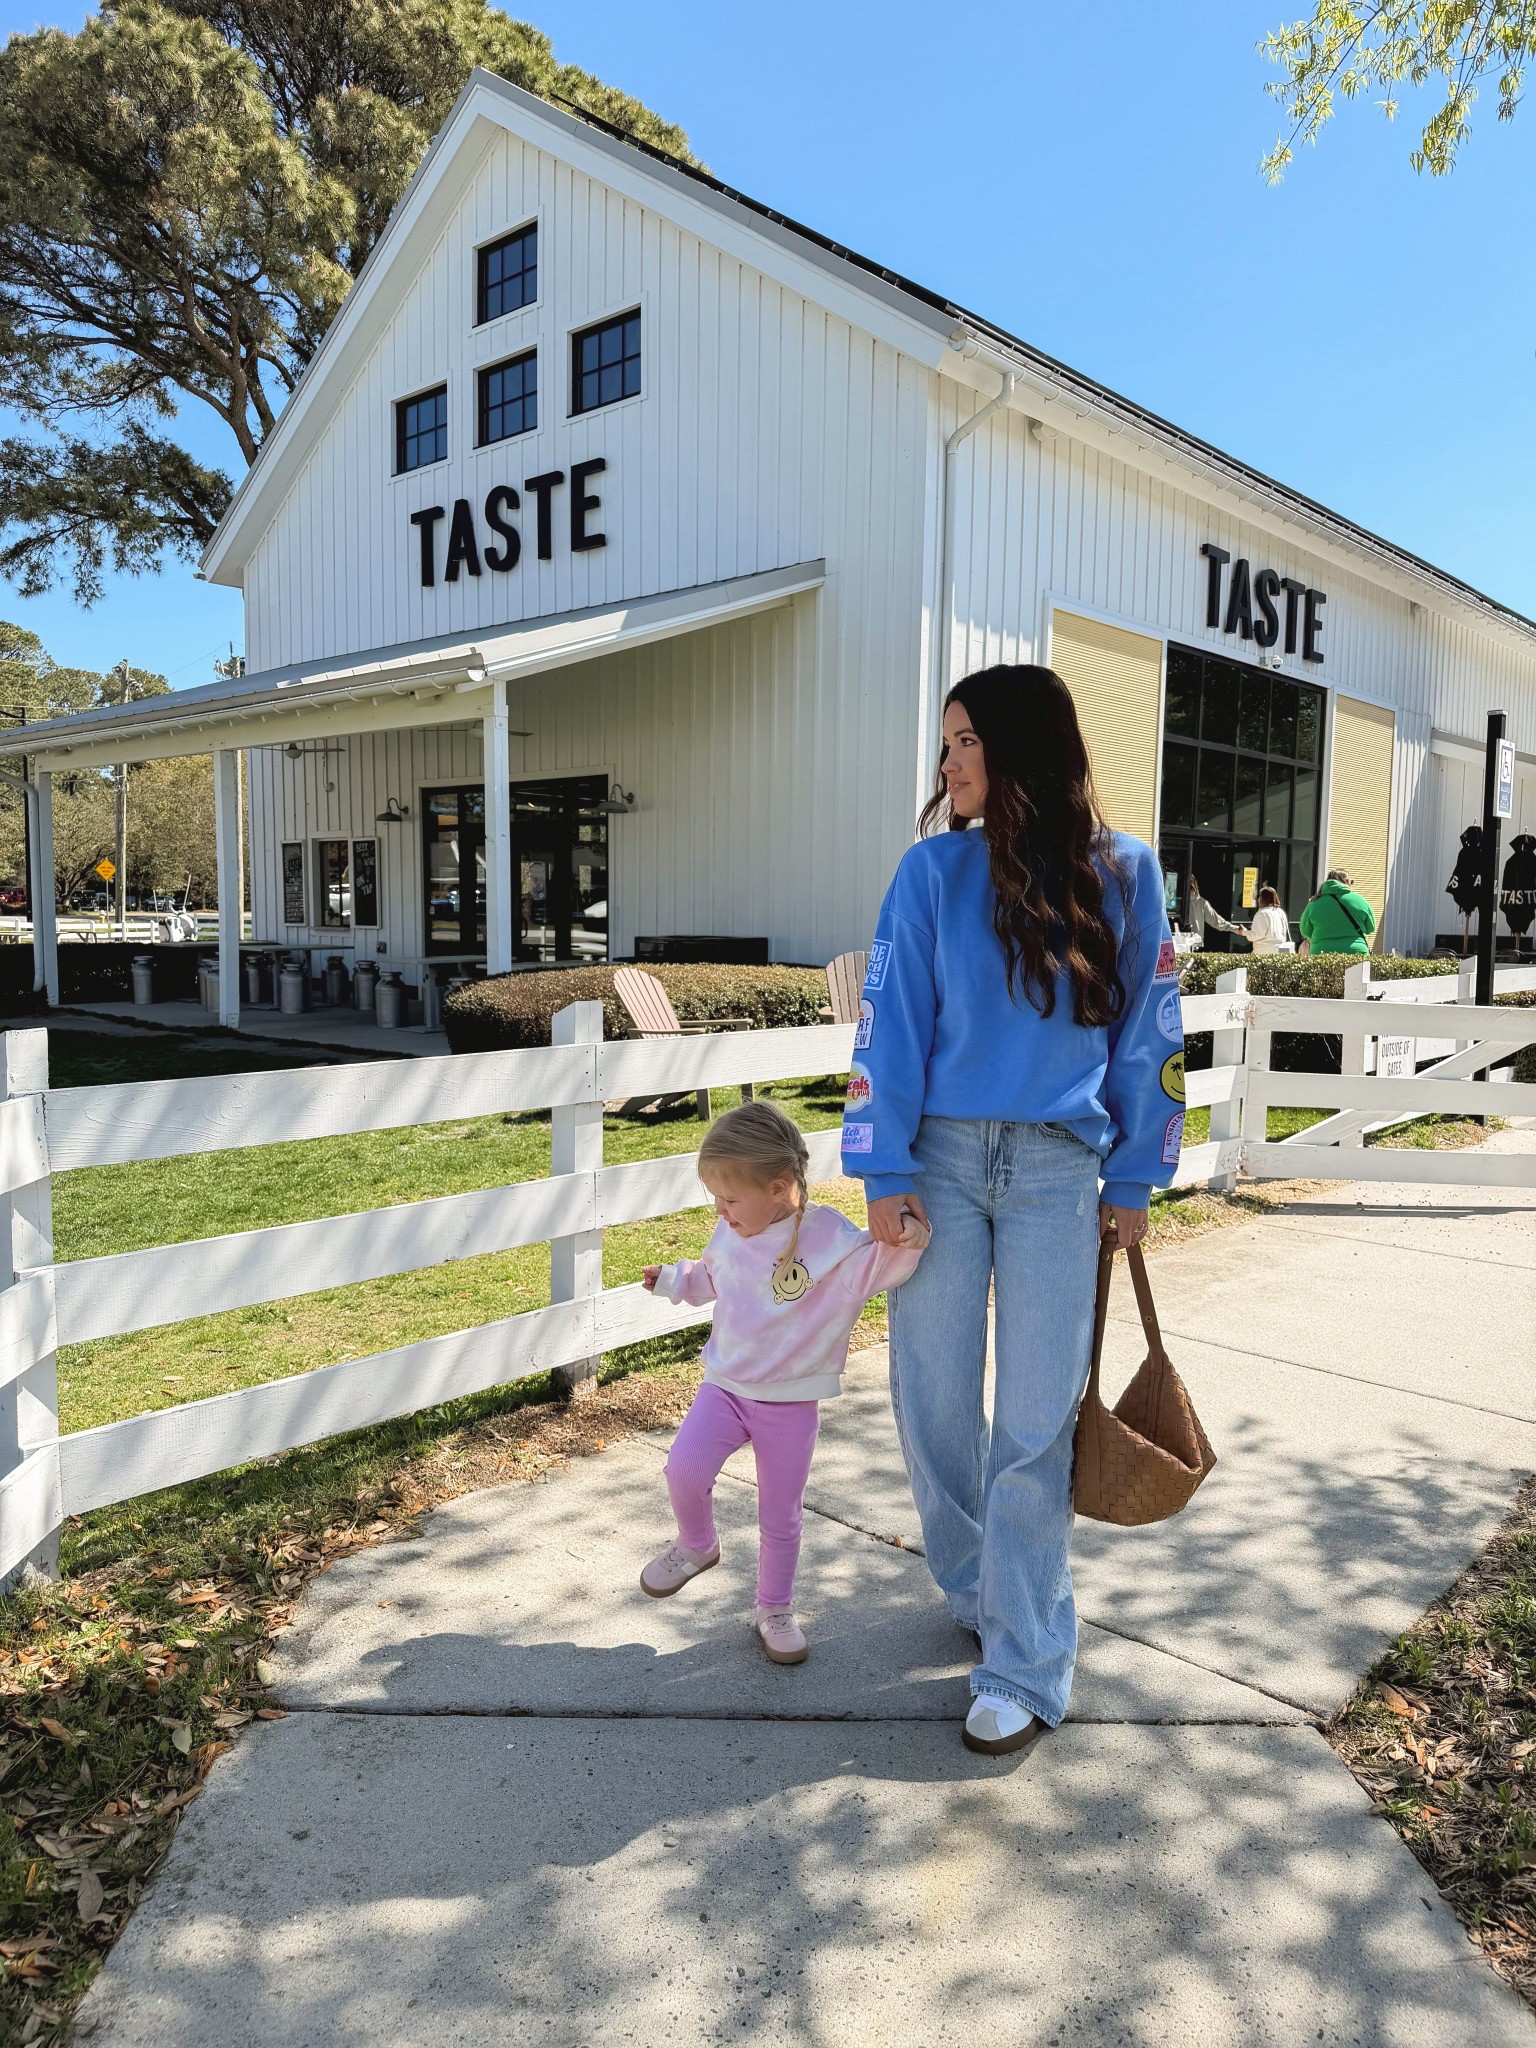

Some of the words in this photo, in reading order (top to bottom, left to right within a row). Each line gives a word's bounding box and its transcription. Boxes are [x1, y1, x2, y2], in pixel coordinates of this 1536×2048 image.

[411, 457, 606, 588] TASTE
[1201, 543, 1327, 664] TASTE
[1381, 1041, 1402, 1058] OUTSIDE
[1403, 1040, 1410, 1055] OF
